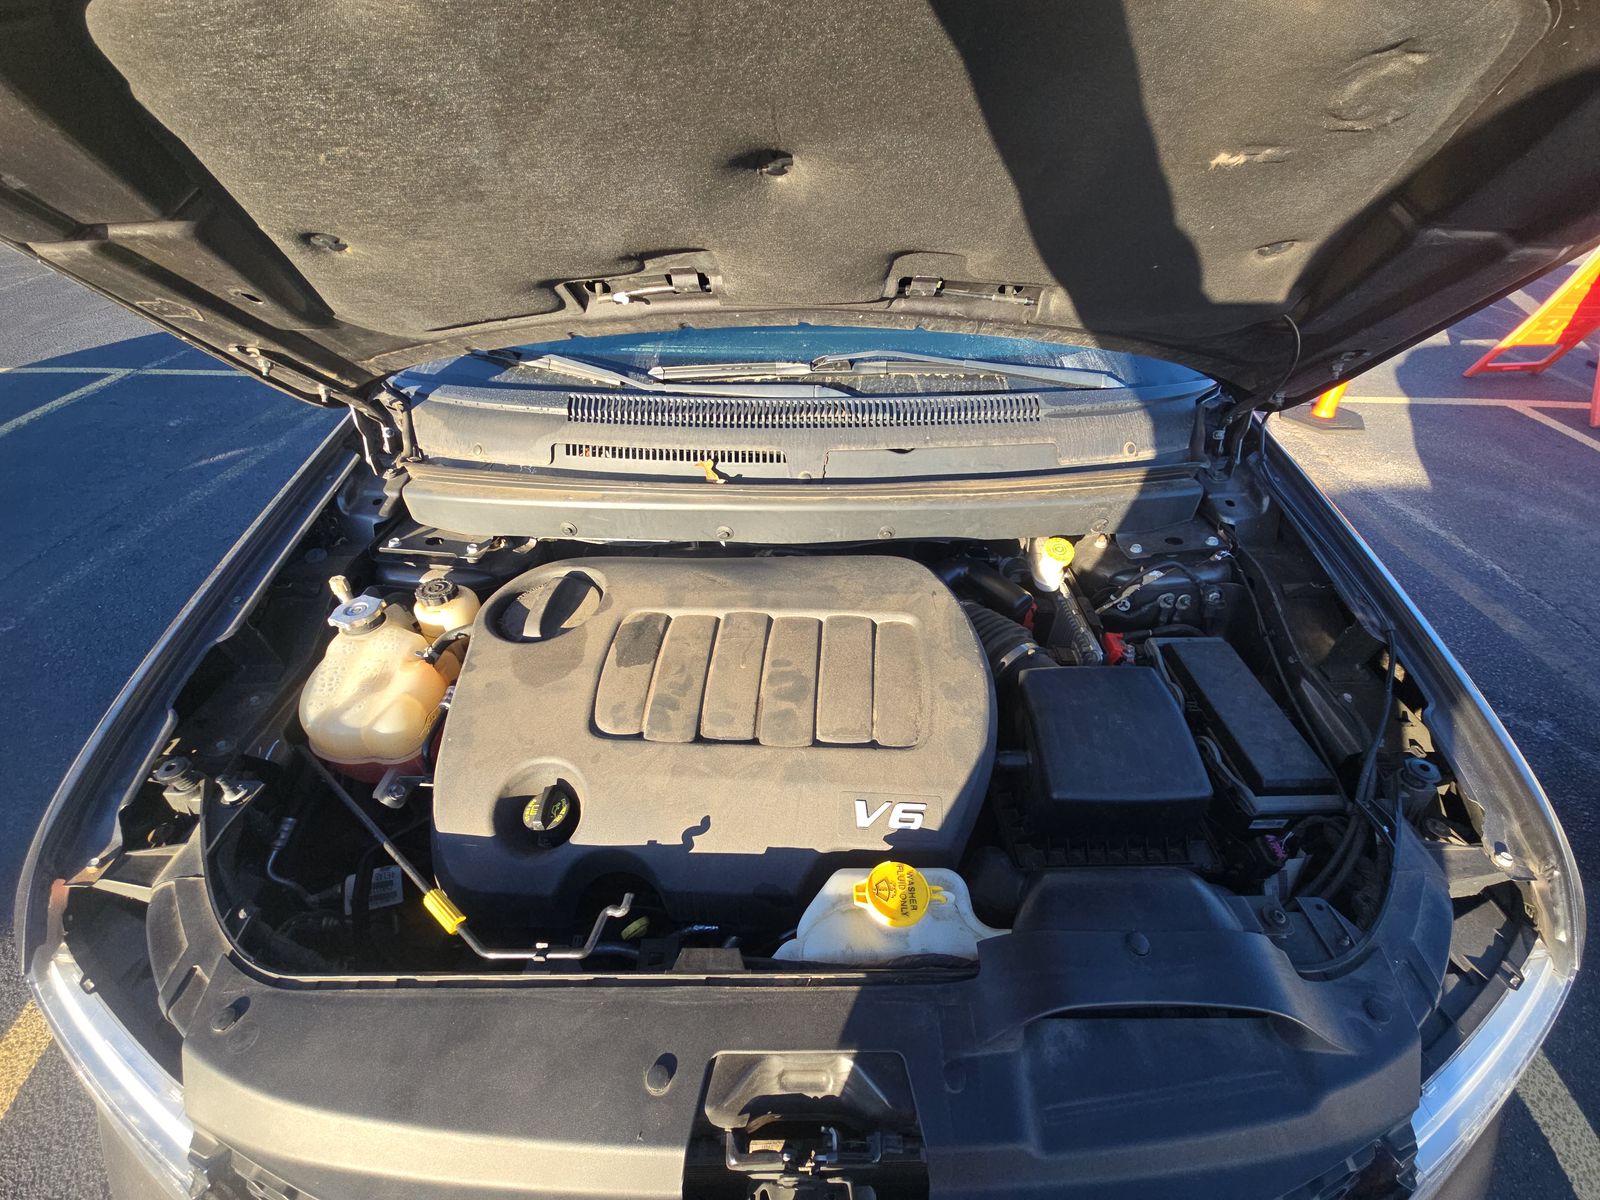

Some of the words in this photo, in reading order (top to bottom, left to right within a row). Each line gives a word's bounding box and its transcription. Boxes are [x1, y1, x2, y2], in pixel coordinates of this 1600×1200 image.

[854, 799, 928, 830] V6
[896, 864, 906, 891] FLUID
[907, 870, 918, 911] WASHER
[900, 893, 909, 917] ONLY
